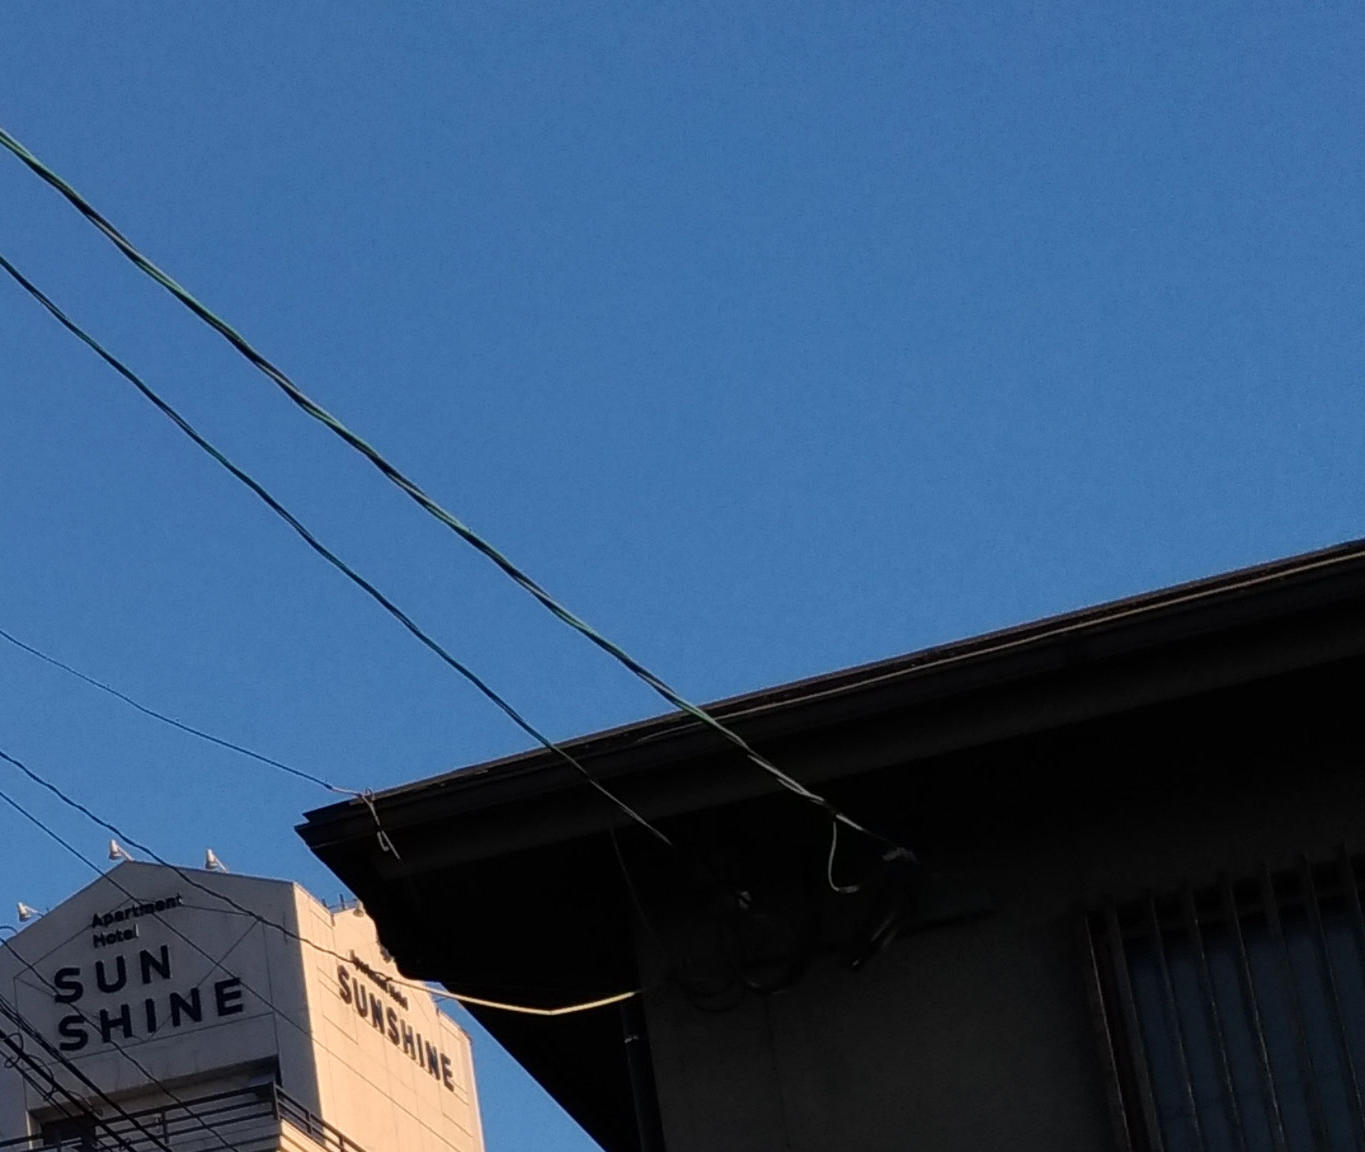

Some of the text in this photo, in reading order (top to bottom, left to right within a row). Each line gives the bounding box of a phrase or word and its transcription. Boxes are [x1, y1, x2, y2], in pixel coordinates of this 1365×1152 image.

[92, 922, 139, 949] Hotel
[53, 945, 172, 1004] SUN
[58, 977, 245, 1052] SHINE
[337, 964, 455, 1093] SUNSHINE
